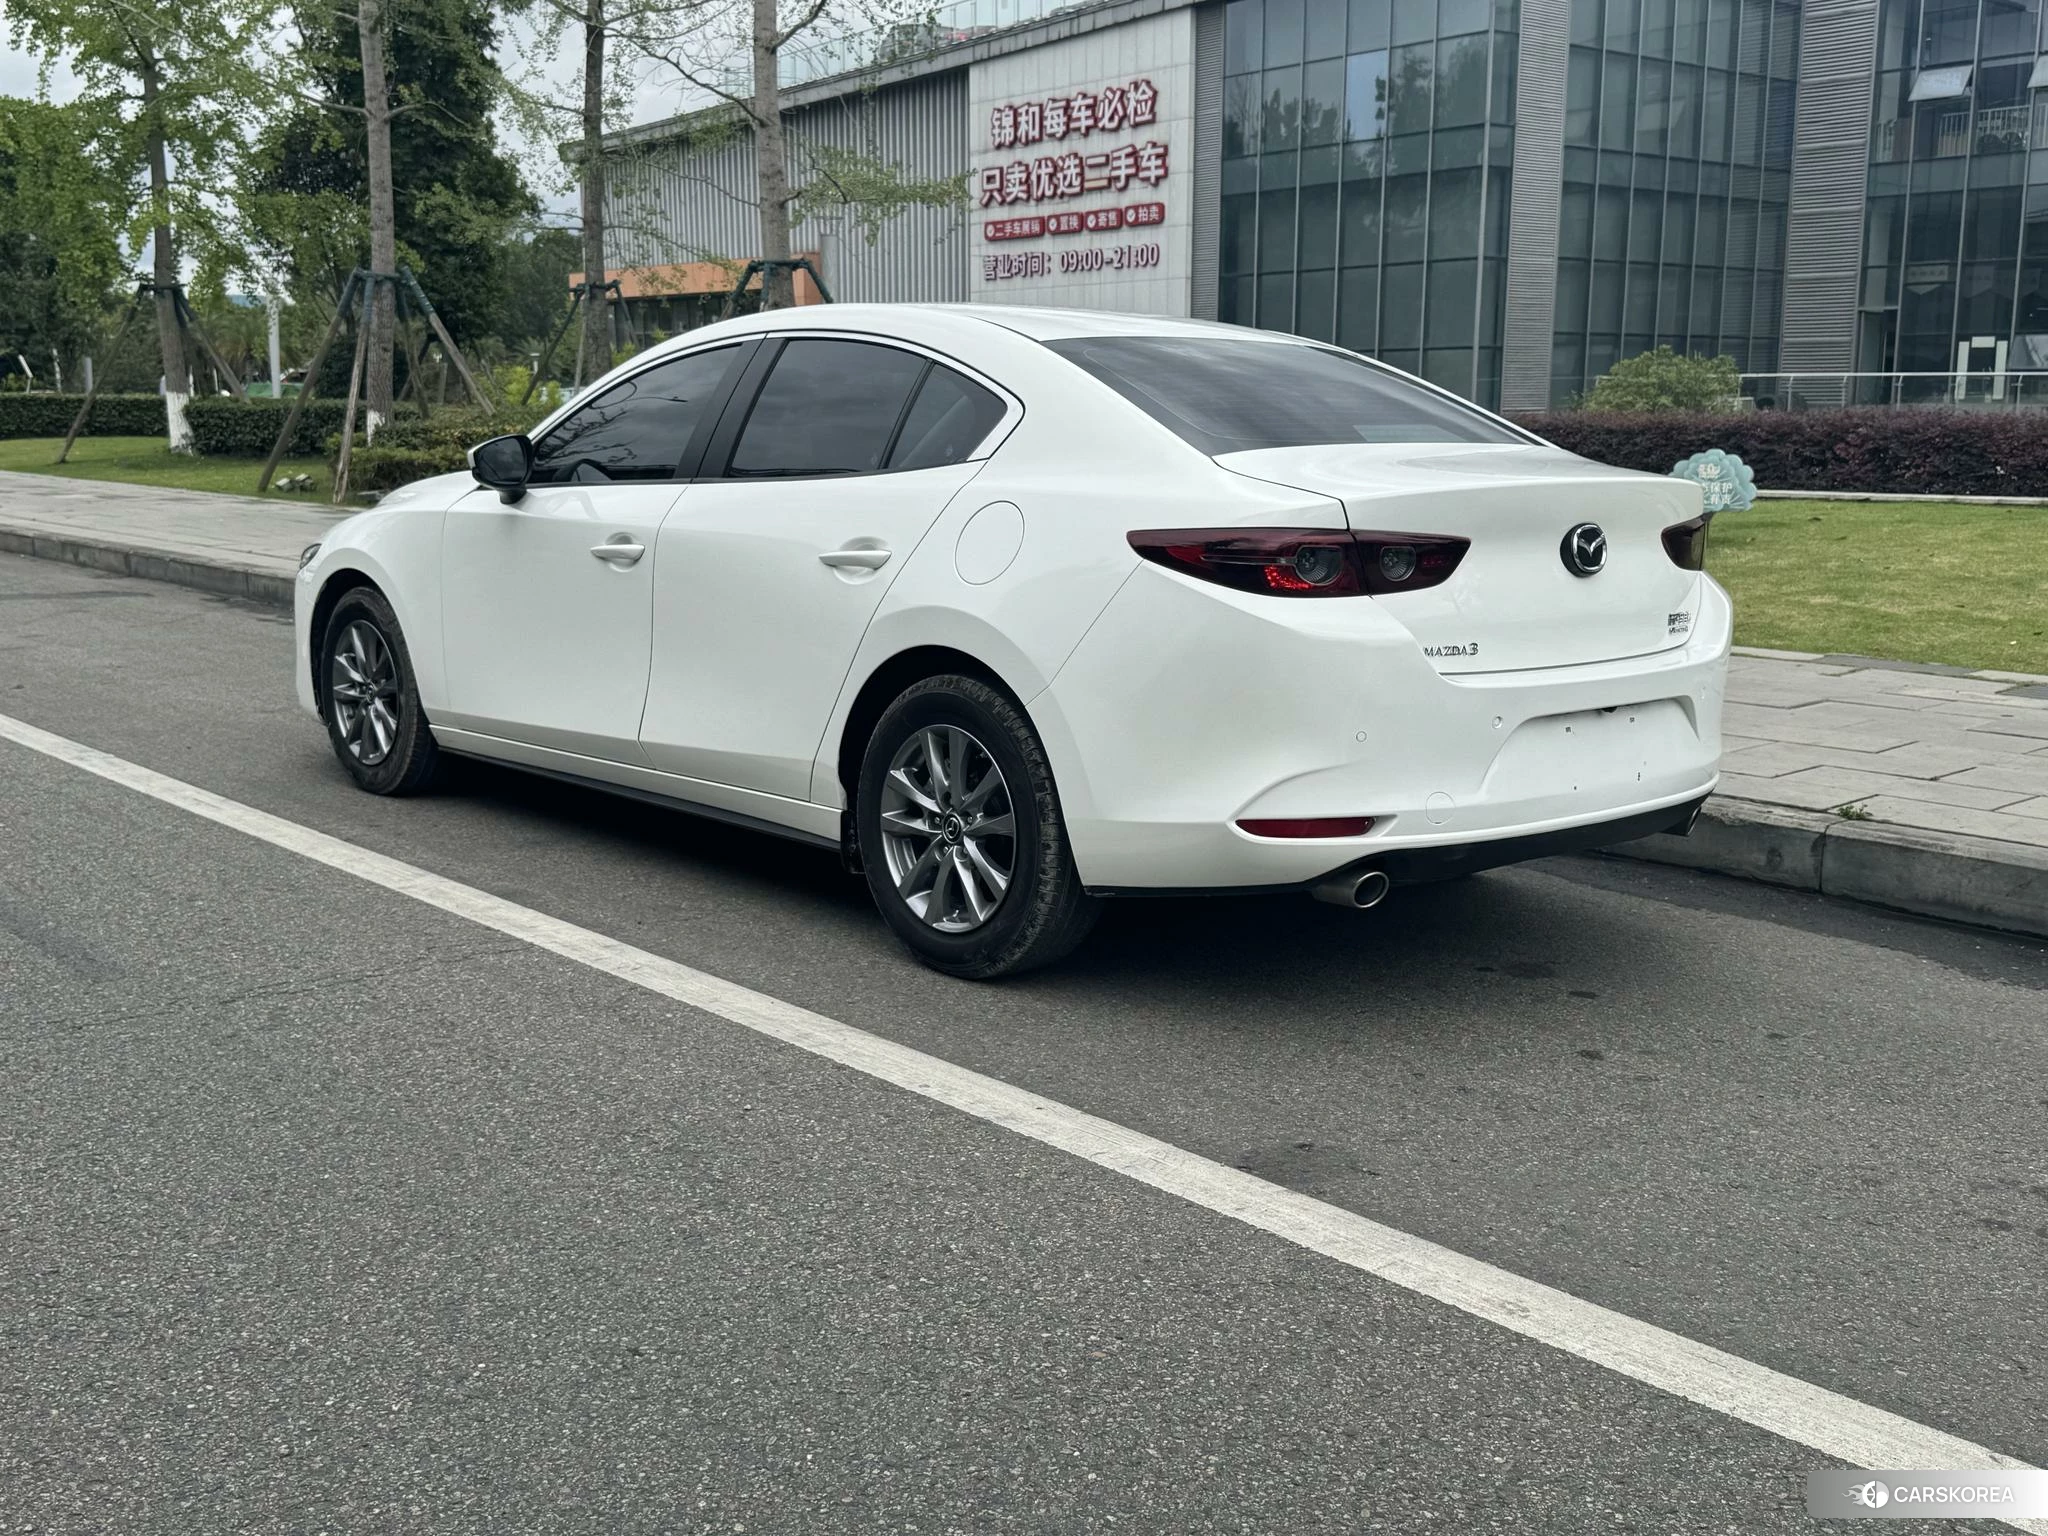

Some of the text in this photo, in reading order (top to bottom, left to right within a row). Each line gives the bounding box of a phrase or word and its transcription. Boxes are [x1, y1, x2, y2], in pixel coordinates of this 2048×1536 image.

[991, 79, 1157, 148] 锦和每车必检
[980, 141, 1169, 207] 只卖优选二手车
